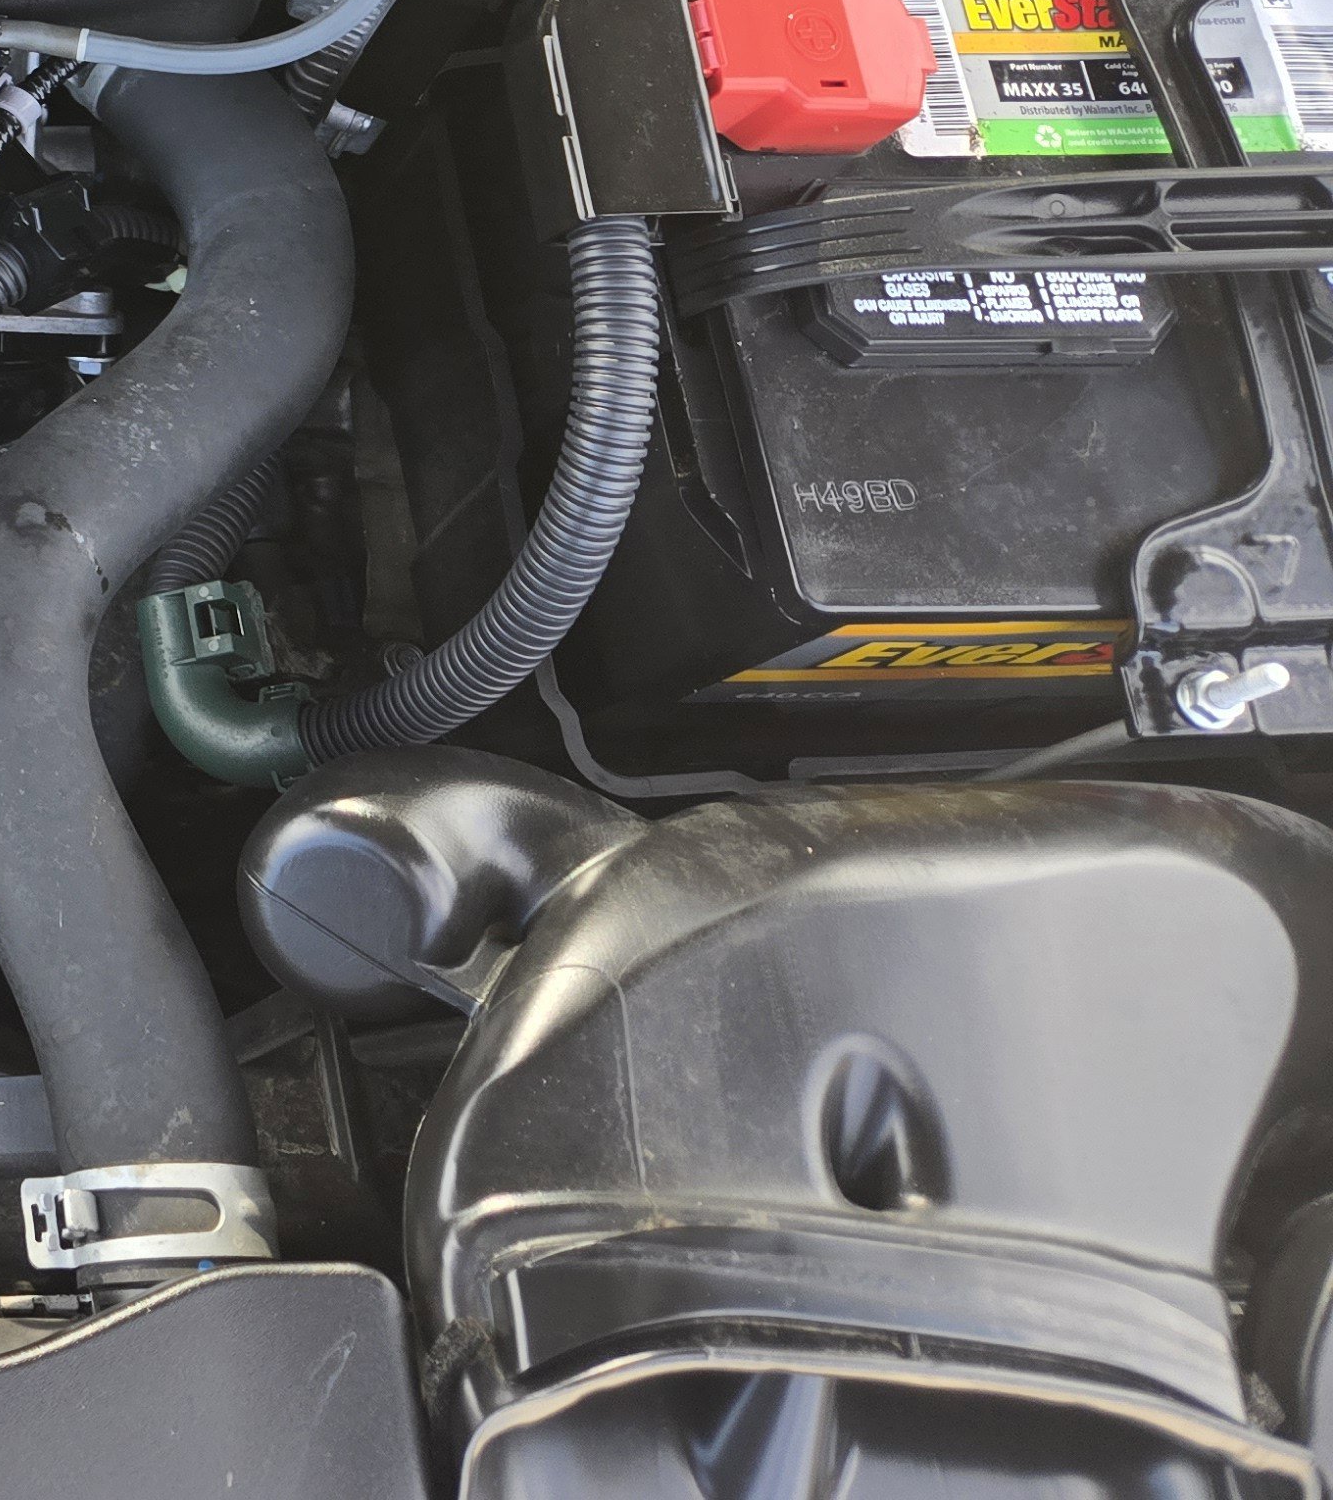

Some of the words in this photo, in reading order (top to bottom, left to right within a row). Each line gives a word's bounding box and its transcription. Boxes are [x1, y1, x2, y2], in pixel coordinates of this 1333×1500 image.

[1009, 63, 1029, 71] Part
[1029, 63, 1063, 71] Number
[1003, 83, 1058, 97] MAXX
[1062, 82, 1083, 96] 35
[1020, 105, 1071, 116] Distributed
[1072, 105, 1083, 116] by
[1083, 104, 1122, 115] Walmart
[885, 283, 931, 298] GASES
[1049, 283, 1076, 296] CAN
[1077, 283, 1117, 296] CAUSE
[853, 299, 877, 312] CAN
[878, 299, 912, 311] CAUSE
[1120, 295, 1141, 308] OR
[889, 312, 907, 325] OR
